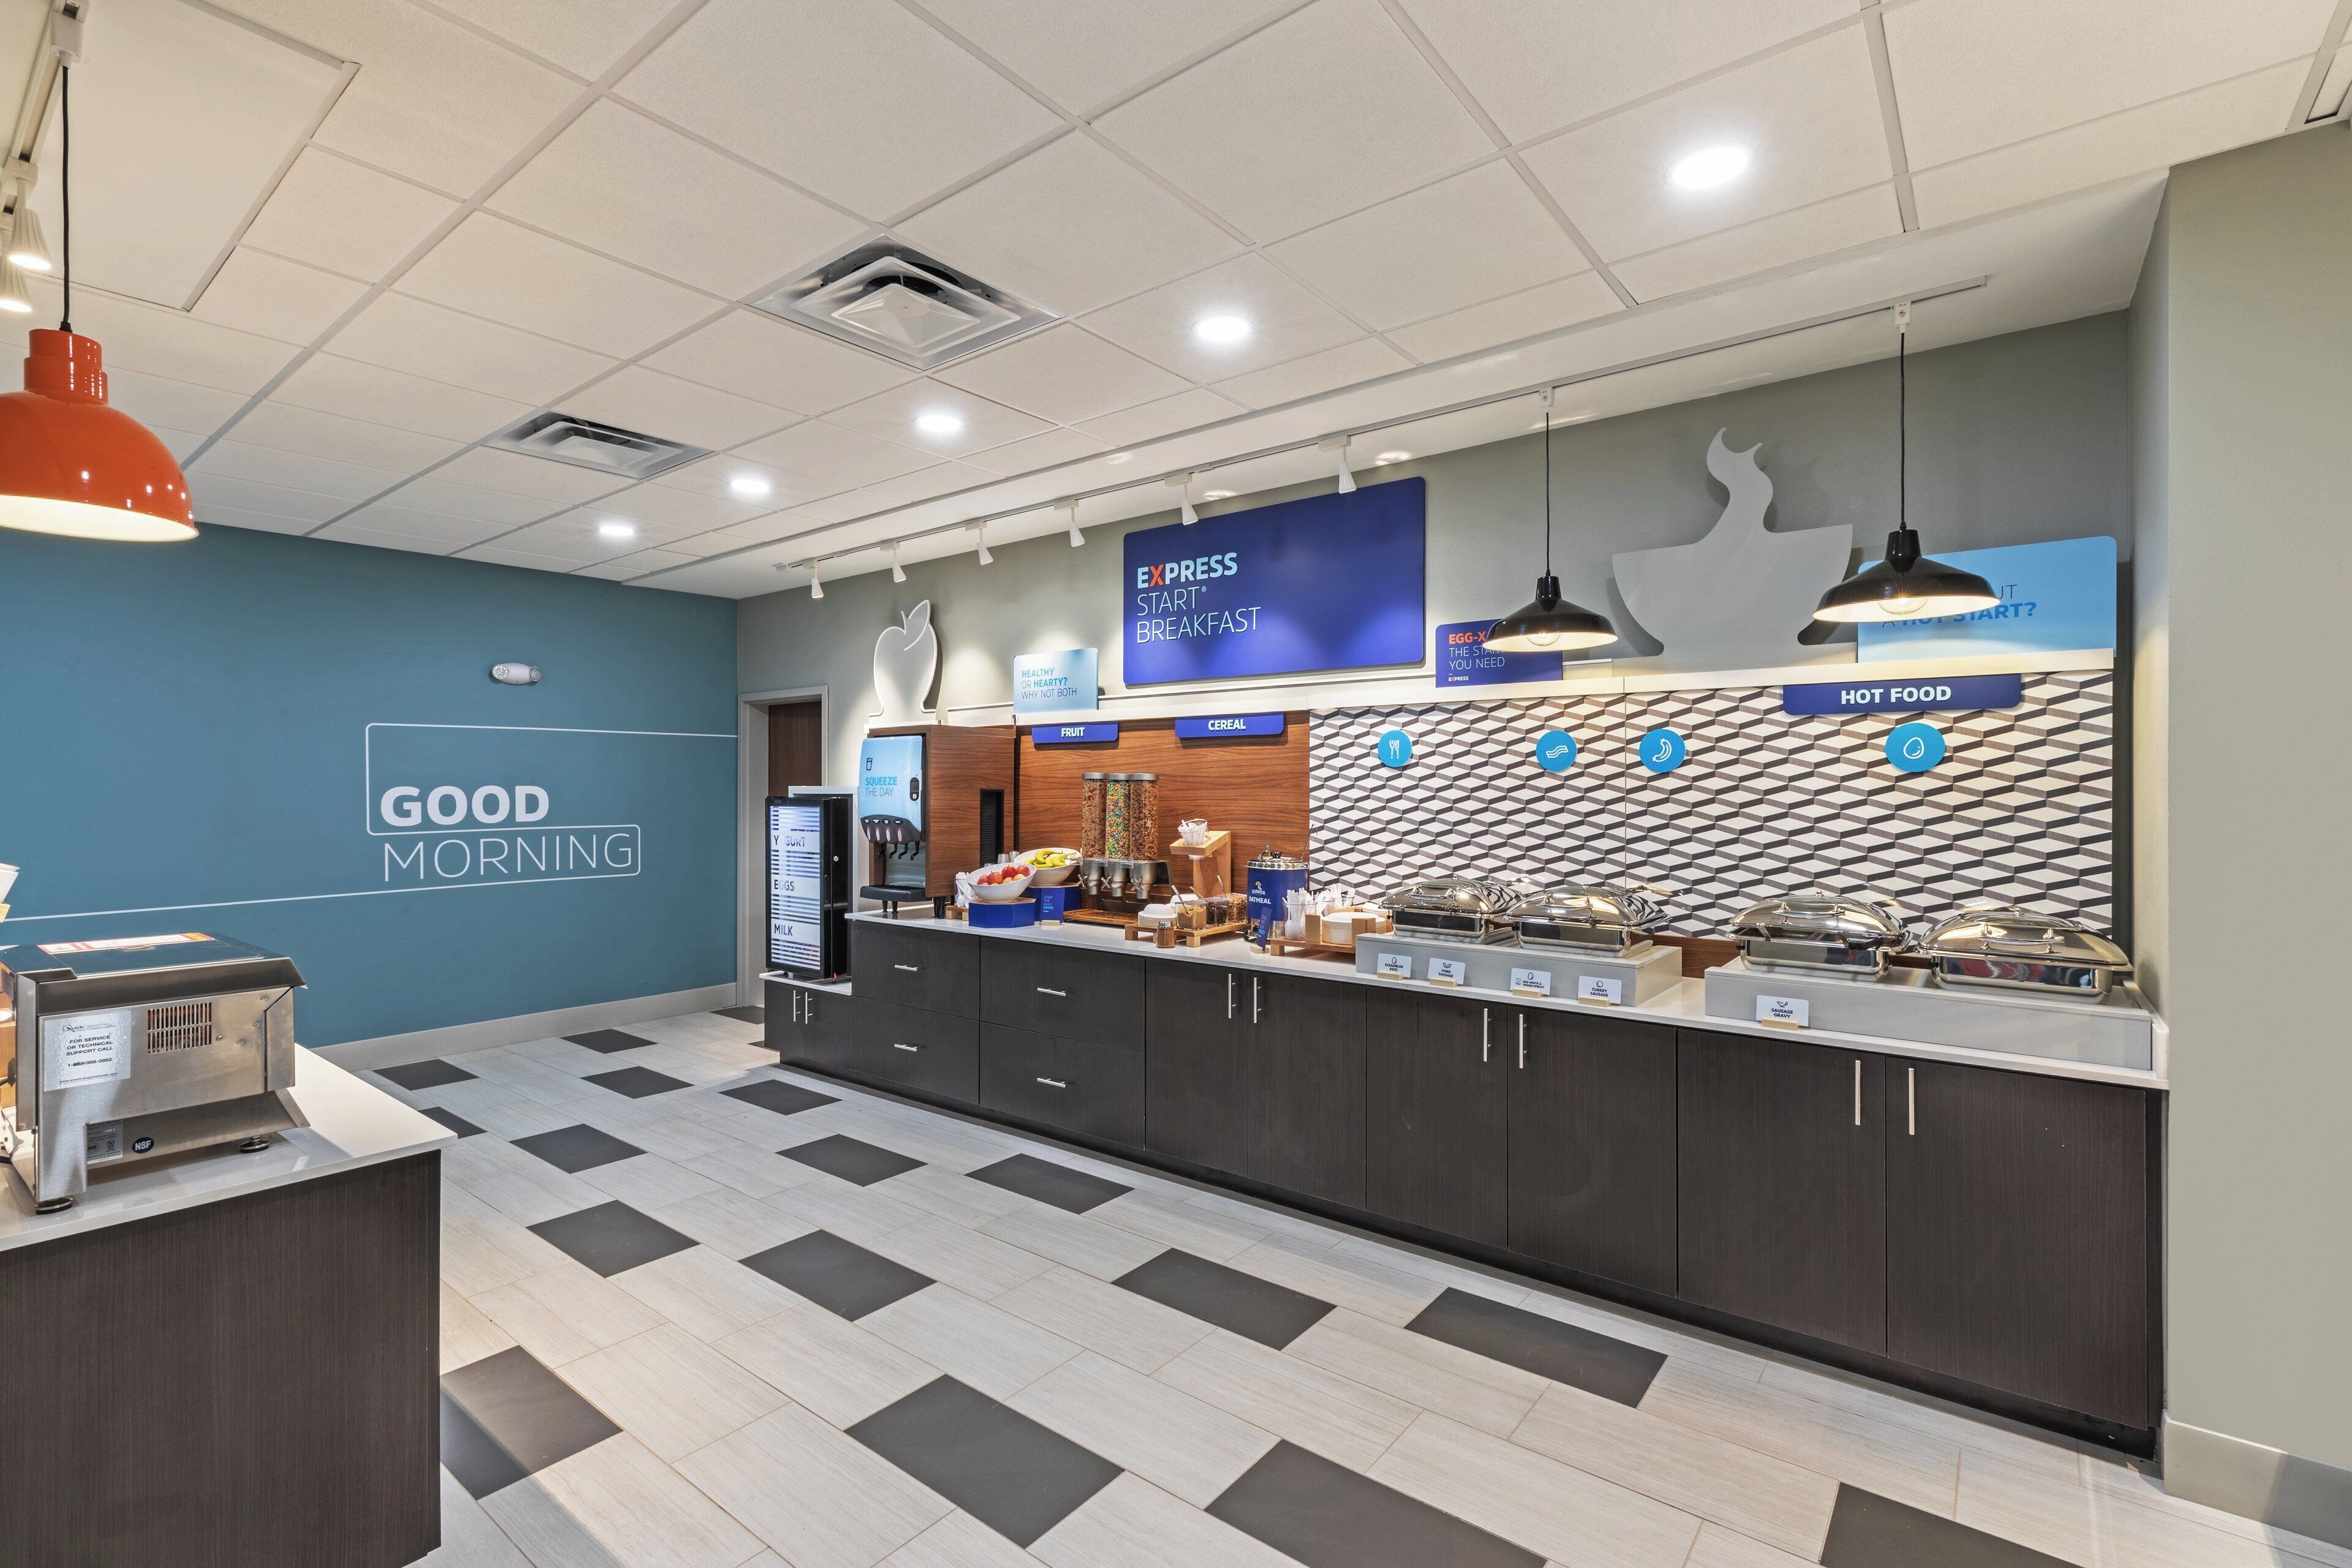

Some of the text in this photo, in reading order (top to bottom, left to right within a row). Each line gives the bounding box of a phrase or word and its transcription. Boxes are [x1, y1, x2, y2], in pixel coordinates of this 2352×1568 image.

[1137, 552, 1238, 589] EXPRESS
[1137, 606, 1261, 643] BREAKFAST
[1449, 646, 1469, 657] THE
[1449, 657, 1505, 670] YOU NEED
[1022, 668, 1054, 678] HEALTHY
[1022, 677, 1068, 689] OR HEARTY?
[1022, 687, 1077, 699] WHY NOT BOTH
[1841, 685, 1951, 705] HOT FOOD
[1208, 718, 1246, 731] CEREAL
[1061, 726, 1085, 737] FRUIT
[865, 777, 897, 786] SQUEEZE
[865, 787, 894, 796] THE DAY
[380, 785, 549, 827] GOOD
[384, 833, 632, 882] MORNING
[774, 880, 795, 891] EGGS
[1249, 895, 1272, 904] OATMEAL
[774, 924, 793, 936] MILK
[135, 1140, 151, 1151] NSF
